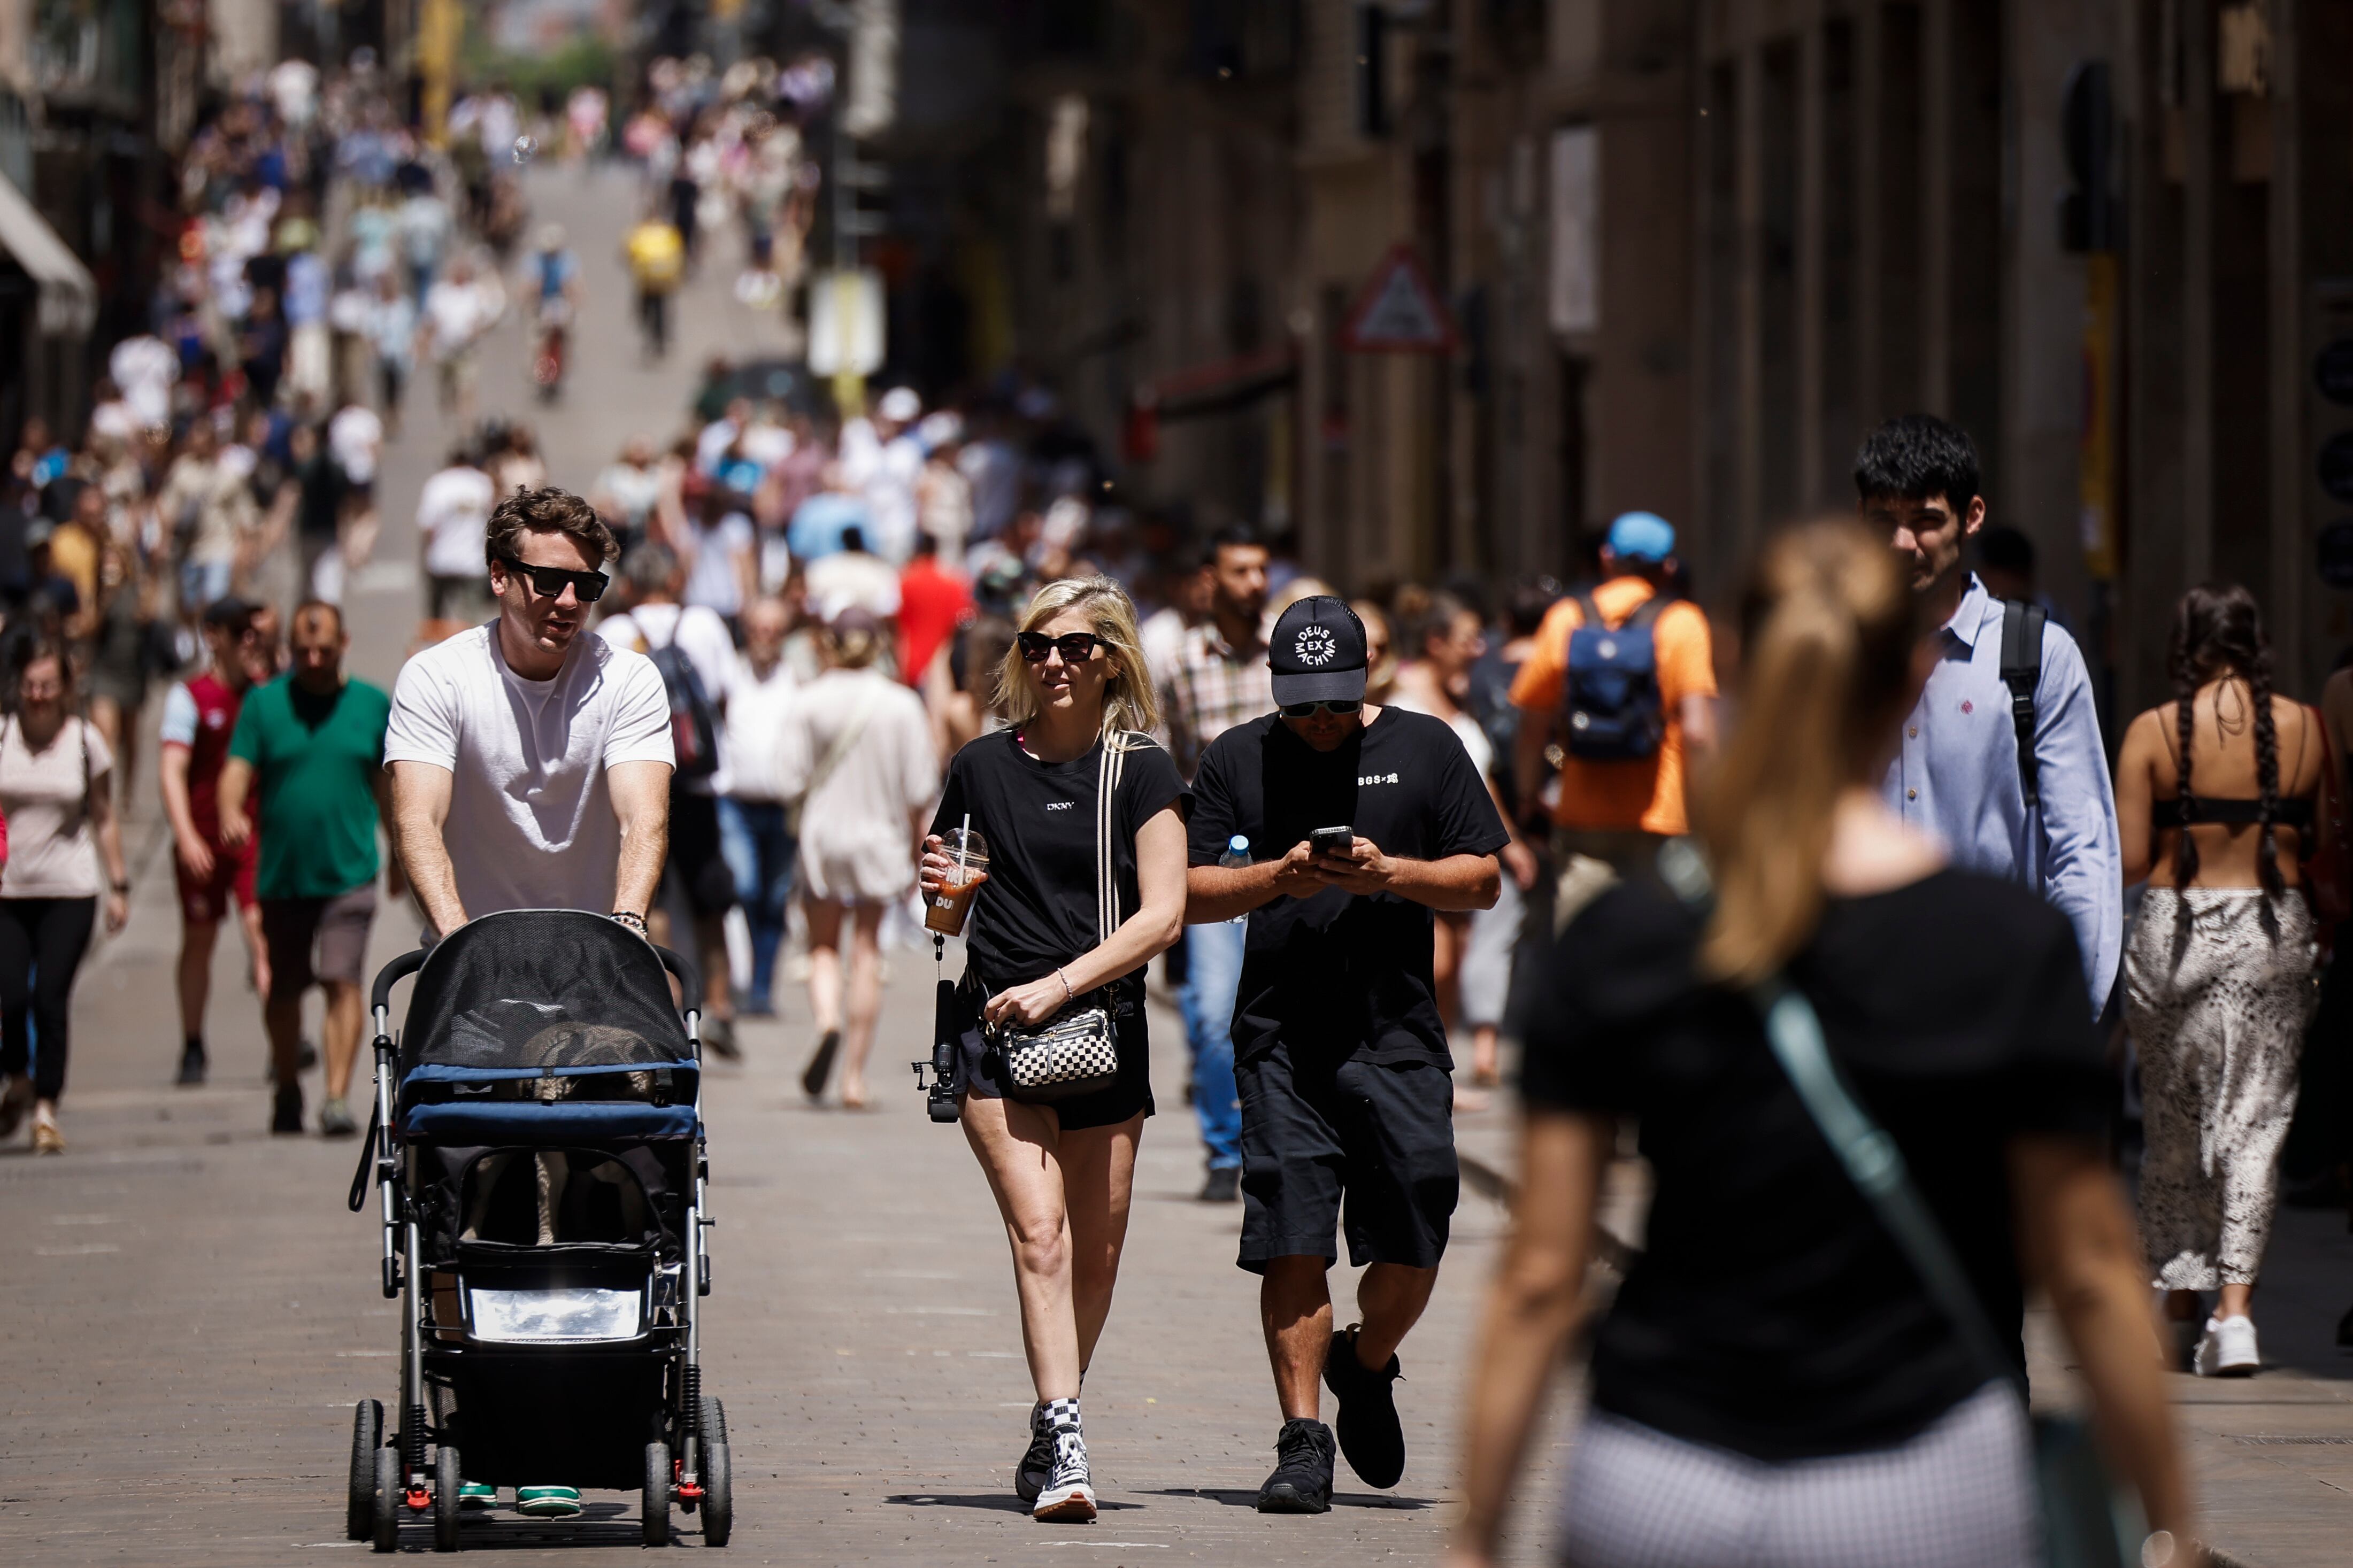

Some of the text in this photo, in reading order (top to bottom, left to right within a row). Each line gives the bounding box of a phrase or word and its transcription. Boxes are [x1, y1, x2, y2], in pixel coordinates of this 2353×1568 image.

[1298, 626, 1330, 642] DEUS
[1295, 639, 1336, 666] MACHINA
[1307, 640, 1323, 651] EX
[1047, 801, 1075, 810] DKNY
[936, 896, 955, 910] DU
